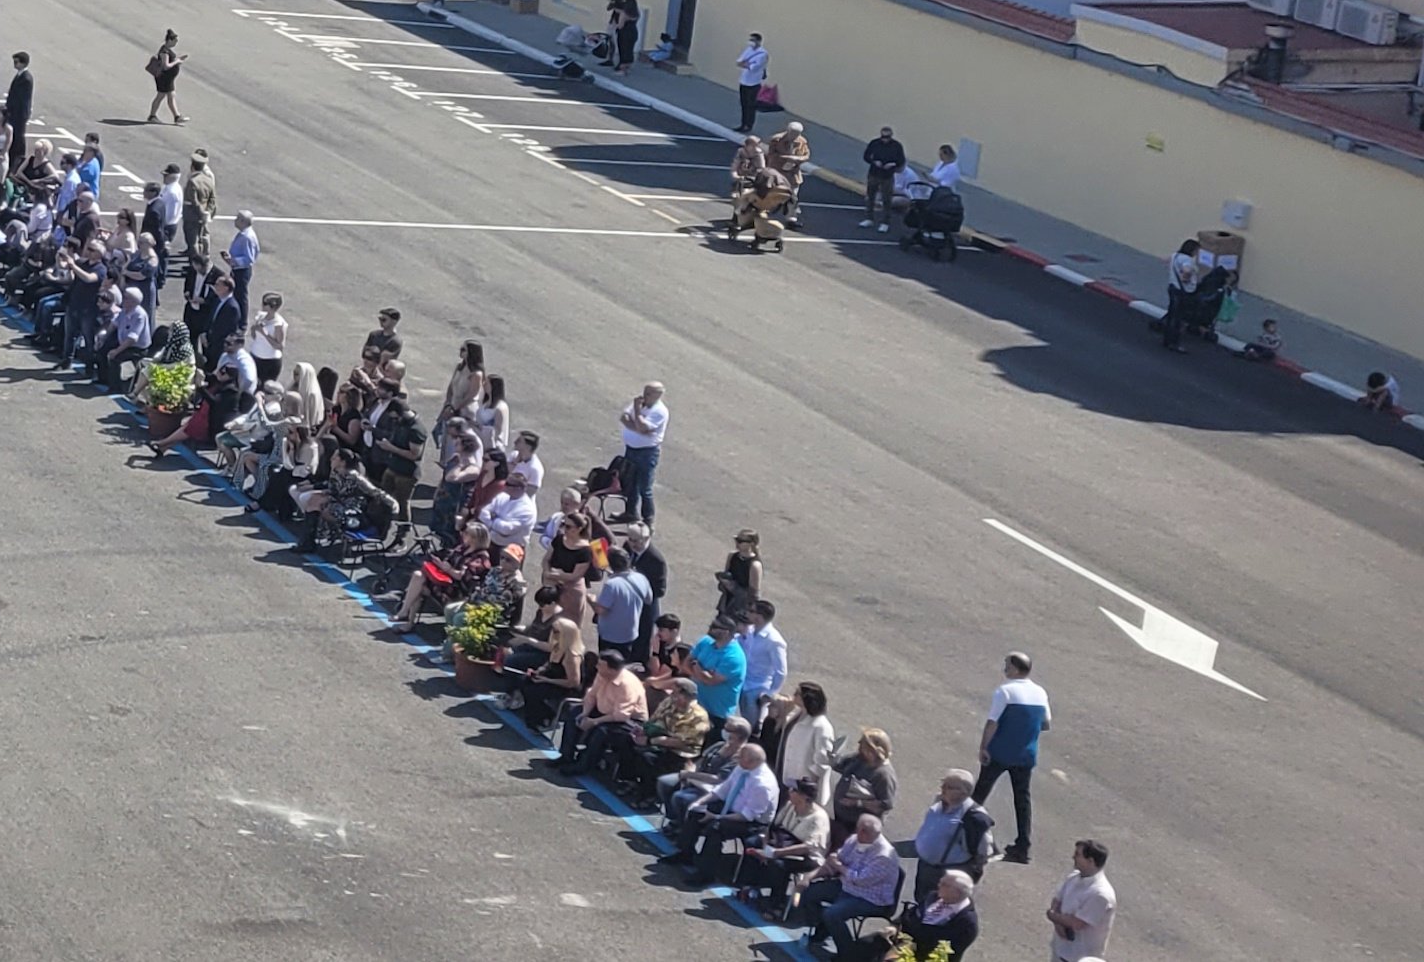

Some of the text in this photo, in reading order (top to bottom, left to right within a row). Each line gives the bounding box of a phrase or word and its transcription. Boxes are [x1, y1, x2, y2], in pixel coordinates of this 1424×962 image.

[258, 17, 300, 31] 124
[369, 71, 418, 88] 126
[432, 101, 484, 118] 127
